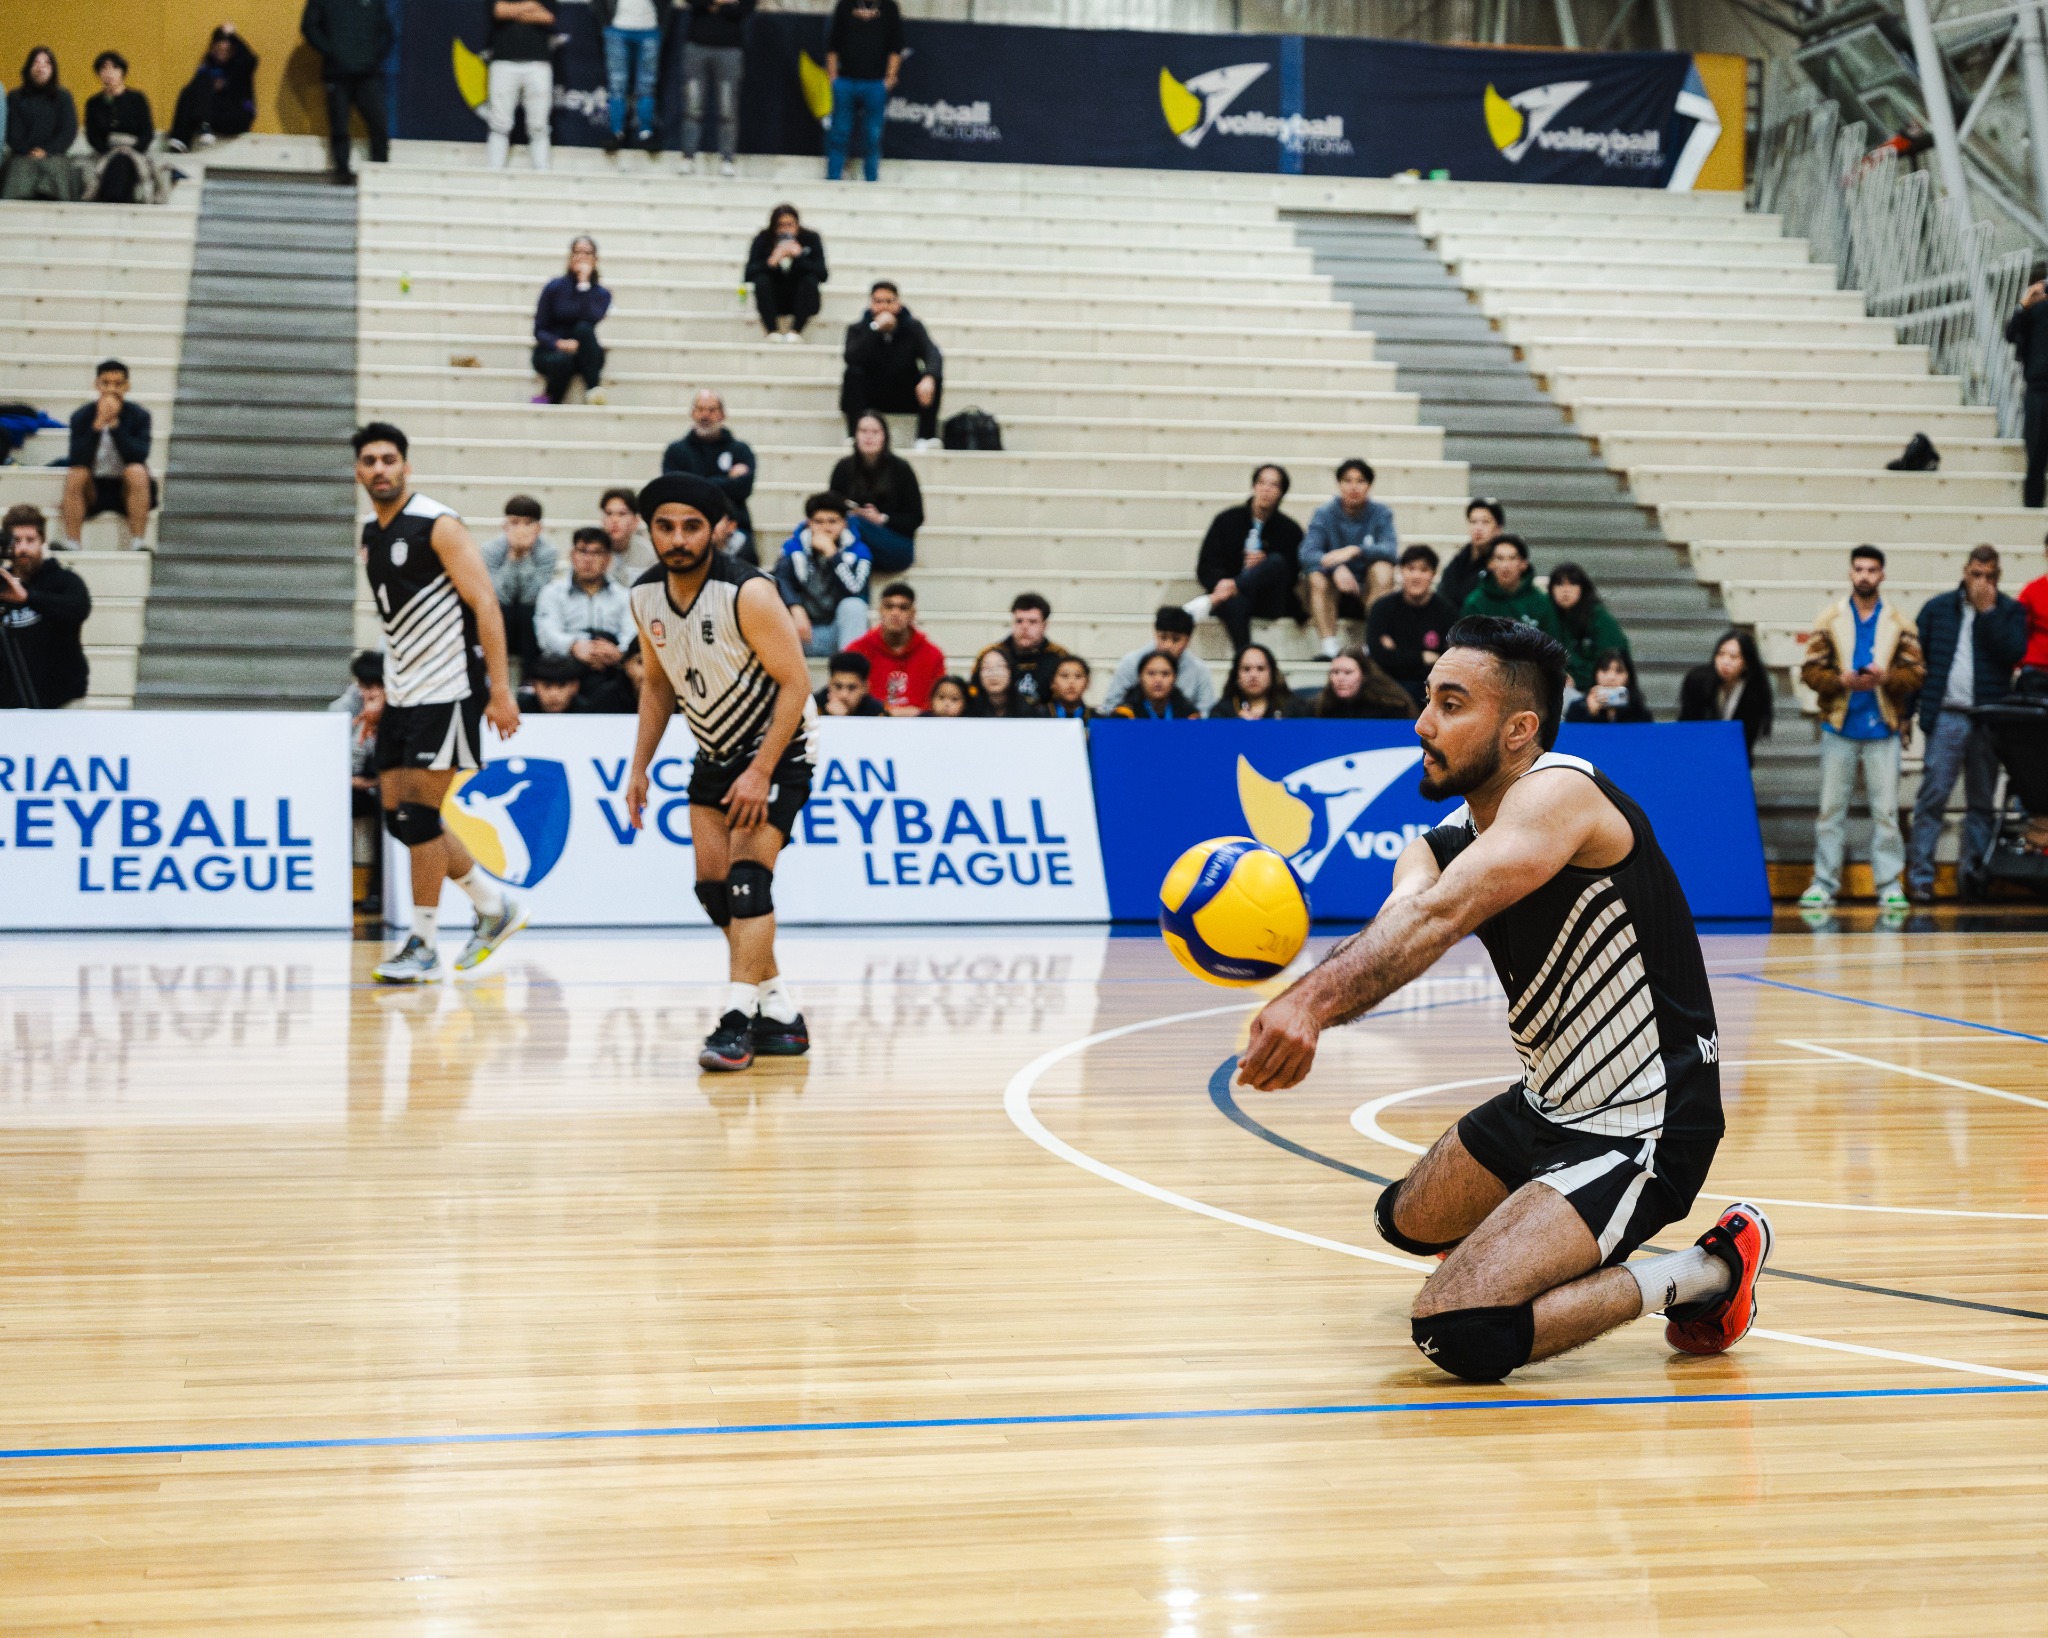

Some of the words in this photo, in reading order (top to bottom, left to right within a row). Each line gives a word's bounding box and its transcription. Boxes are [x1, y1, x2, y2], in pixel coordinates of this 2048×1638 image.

[884, 97, 991, 128] lleyball
[1216, 111, 1343, 142] volleyball
[1539, 126, 1660, 156] volleyball
[378, 583, 391, 614] 1
[685, 667, 706, 698] 10
[0, 799, 313, 848] EYBALL
[597, 798, 1067, 846] VOEYBALL
[78, 855, 314, 892] LEAGUE
[863, 850, 1073, 886] LEAGUE
